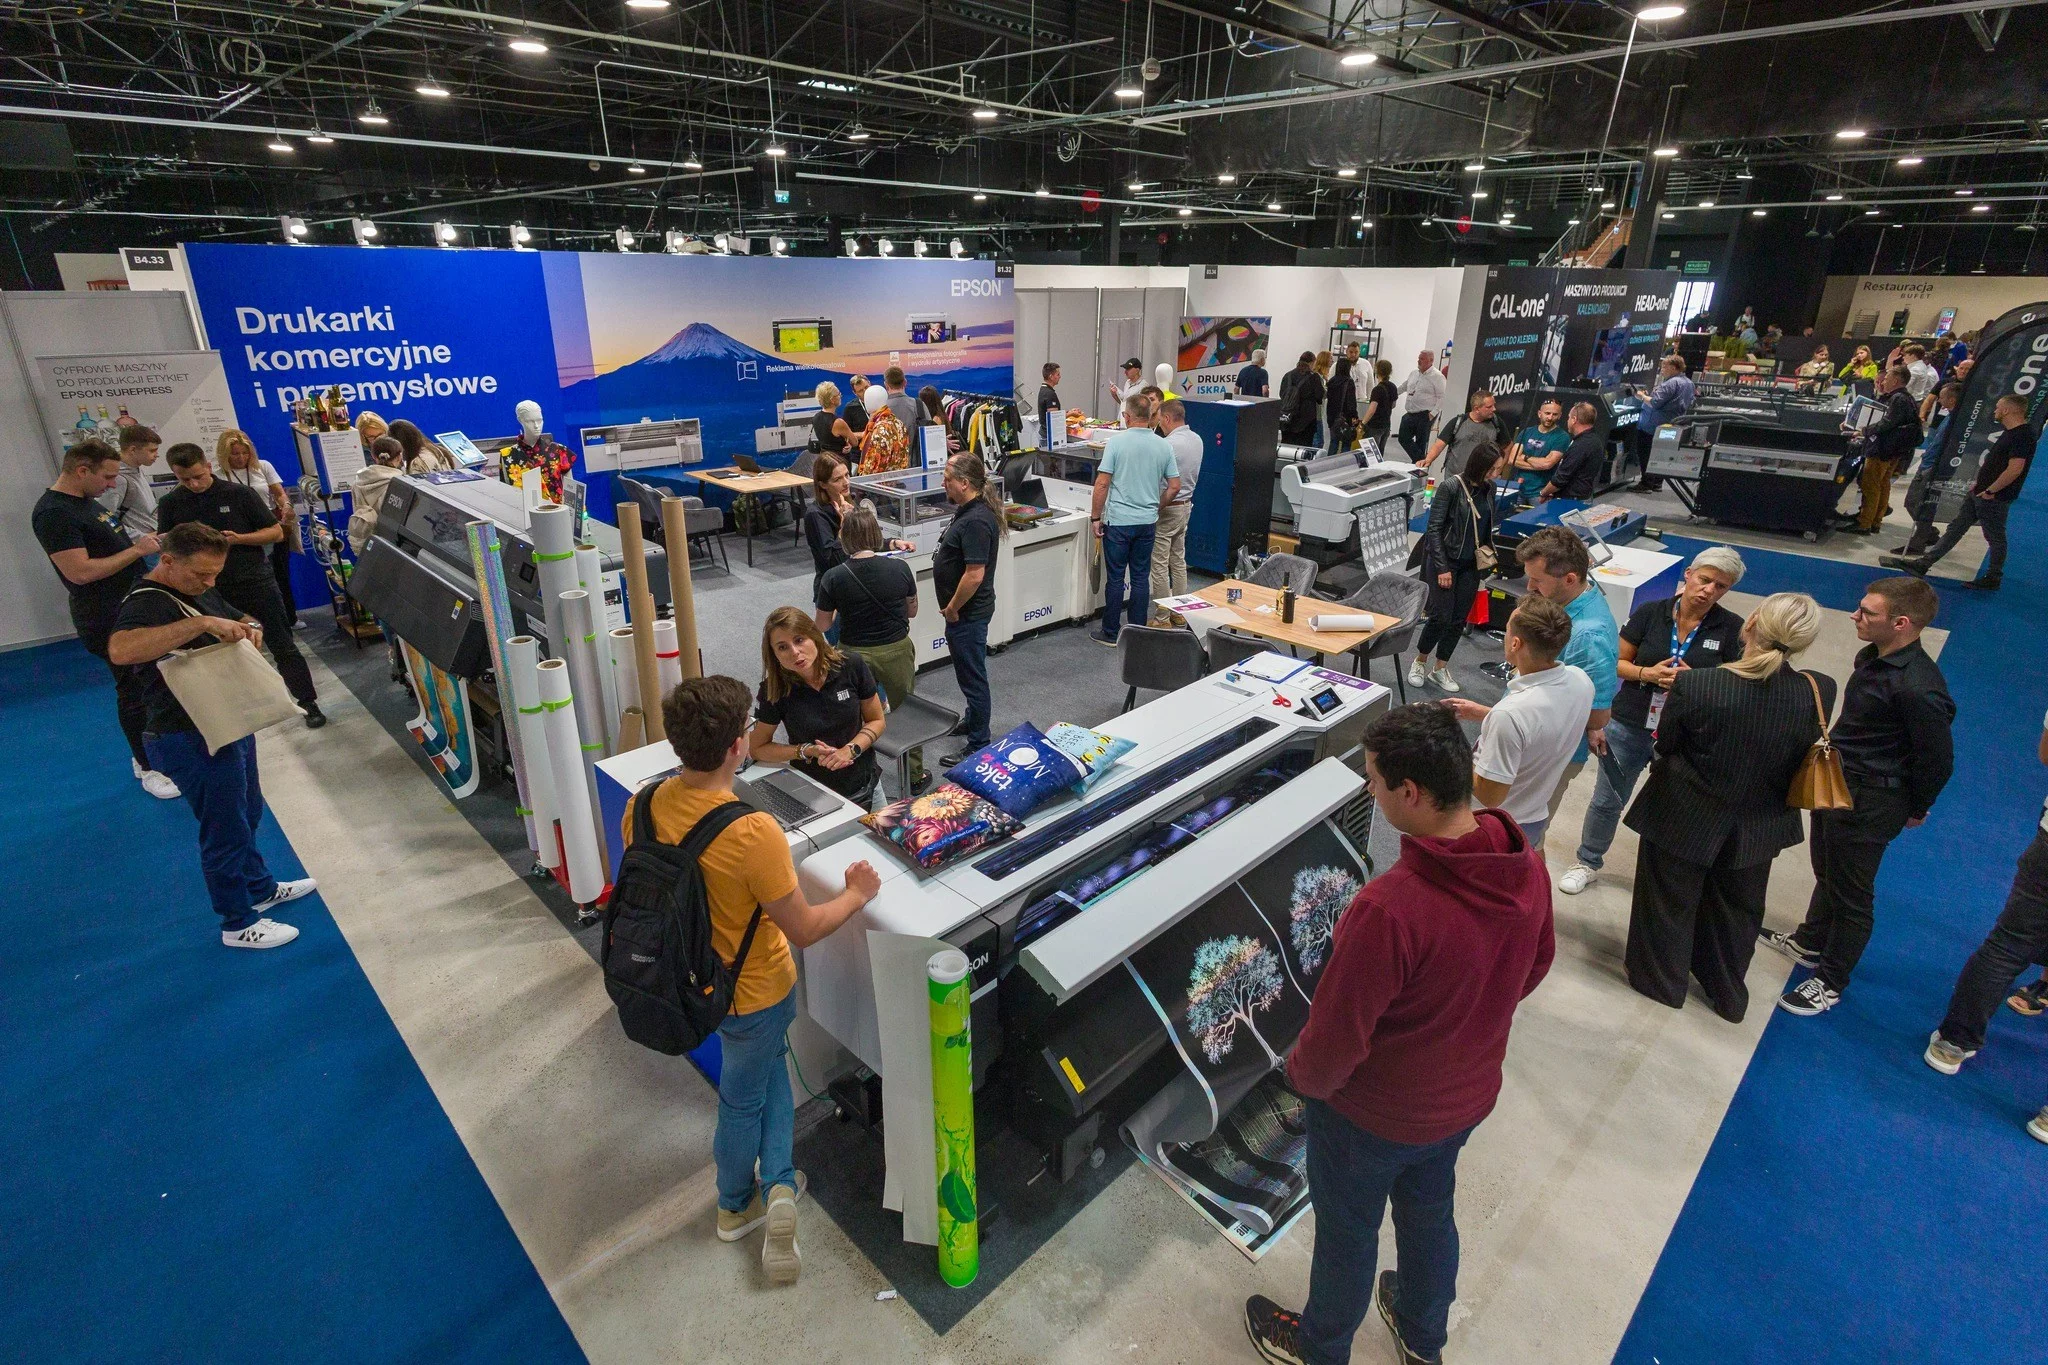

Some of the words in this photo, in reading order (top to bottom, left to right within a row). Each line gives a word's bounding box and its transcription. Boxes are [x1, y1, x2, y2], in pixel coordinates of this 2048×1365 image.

[134, 256, 165, 264] B4.33
[951, 279, 1002, 297] EPSON
[1564, 284, 1591, 297] MASZYNY
[1592, 284, 1601, 296] DO
[1863, 281, 1934, 293] Restauracja
[1490, 293, 1545, 319] CAL-one
[1577, 303, 1612, 315] KALENDARZY
[1635, 295, 1669, 312] HEAD-one
[235, 305, 395, 335] Drukarki
[1484, 336, 1509, 347] AUTOMAT
[1509, 335, 1517, 344] DO
[1518, 334, 1539, 343] KLEJENIA
[244, 339, 452, 371] komercyjne
[944, 350, 967, 358] fotografia
[1493, 349, 1527, 360] KALENDARZY
[53, 364, 112, 376] CYFROWE
[114, 362, 168, 374] MASZYNY
[766, 364, 794, 373] Reklama
[795, 361, 846, 371] wielkoformatowa
[932, 358, 961, 366] artystyczne
[1631, 354, 1645, 373] 720
[56, 378, 75, 388] DO
[79, 375, 144, 387] PRODUKCJI
[147, 373, 190, 384] ETYKIET
[1197, 374, 1237, 383] DRUKSE
[1489, 373, 1515, 396] 1200
[60, 389, 103, 400] EPSON
[106, 386, 173, 398] SUREPRESS
[254, 381, 267, 408] i
[277, 372, 498, 413] przemysłowe
[1197, 386, 1227, 394] ISKRA
[1957, 400, 1983, 454] cal-one.com
[389, 493, 404, 509] EPSON
[1024, 605, 1053, 622] EPSON
[932, 637, 949, 650] EPS
[1003, 761, 1018, 772] the
[975, 762, 1012, 791] take
[968, 952, 989, 973] SON
